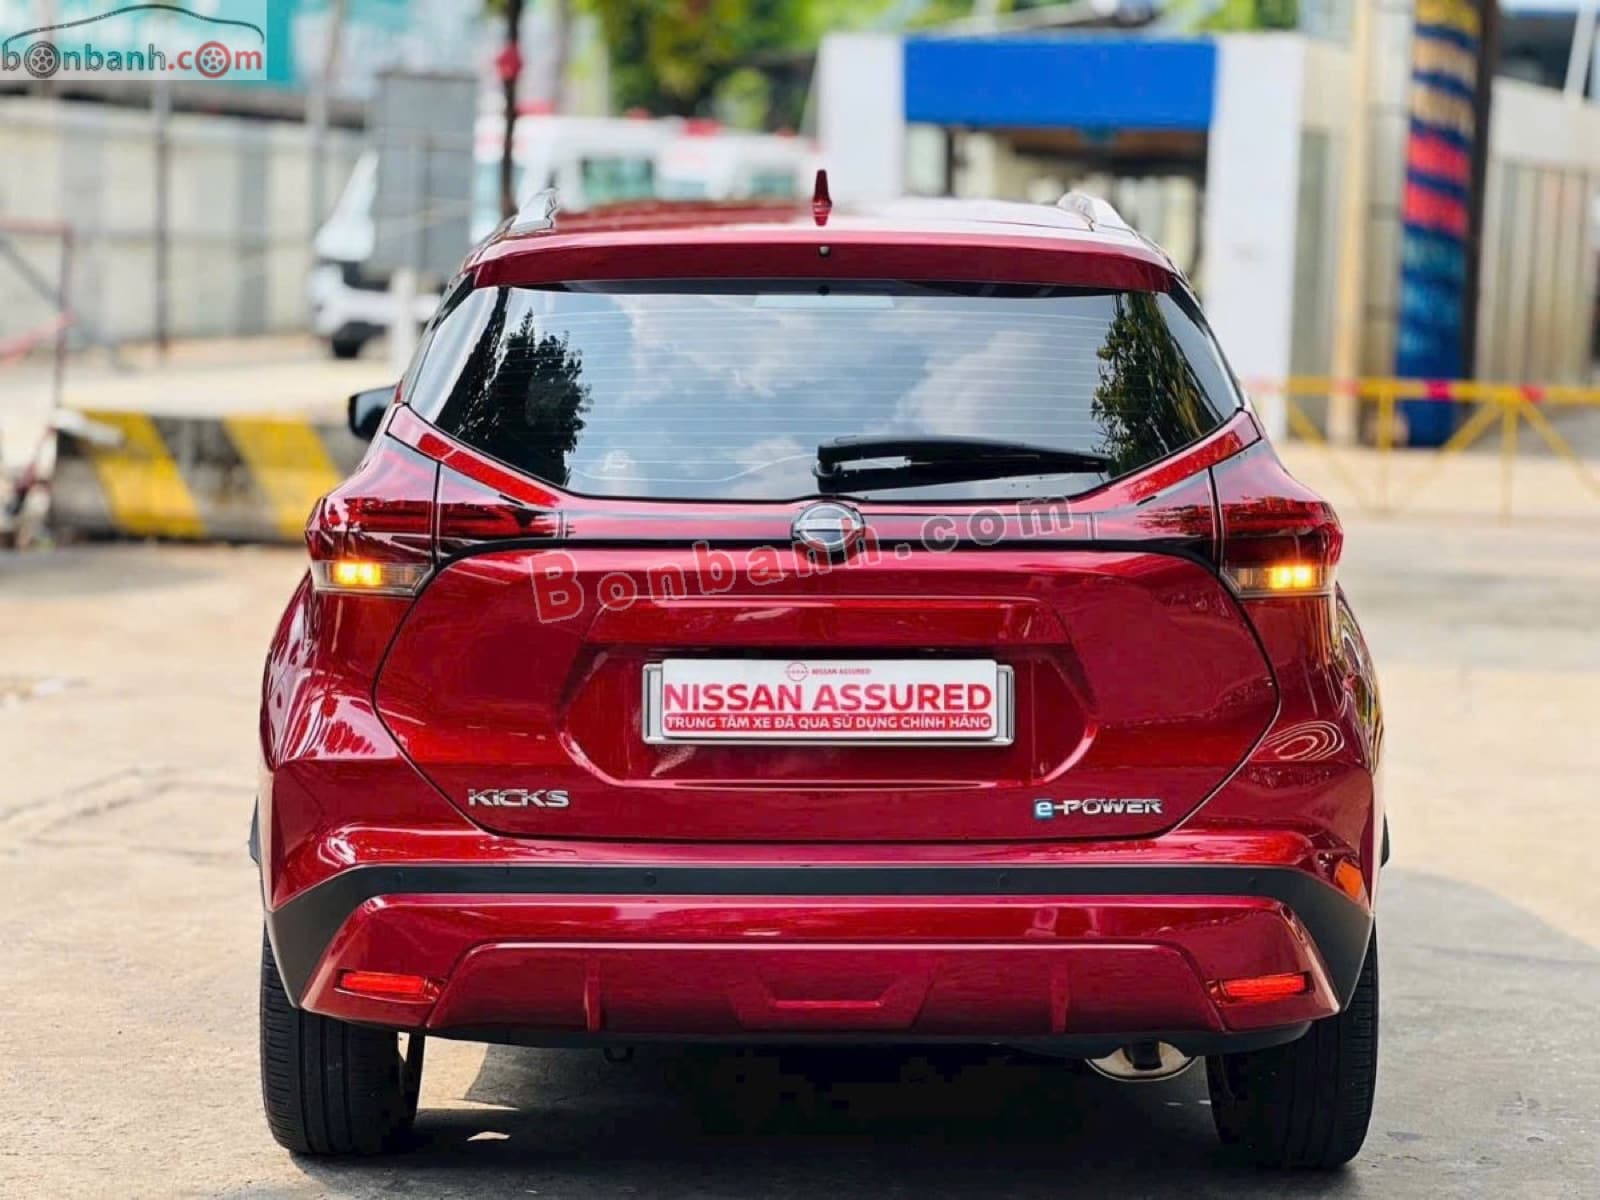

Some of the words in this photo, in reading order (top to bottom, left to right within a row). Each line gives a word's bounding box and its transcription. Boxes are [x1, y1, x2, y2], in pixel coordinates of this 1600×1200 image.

[664, 683, 801, 711] NISSAN
[812, 683, 992, 711] ASSURED
[666, 716, 716, 729] TRUNG
[719, 714, 750, 729] TÂM
[752, 716, 771, 729] XE
[798, 716, 829, 730] QUA
[900, 714, 946, 729] CHÍNH
[1034, 798, 1163, 819] e-POWER
